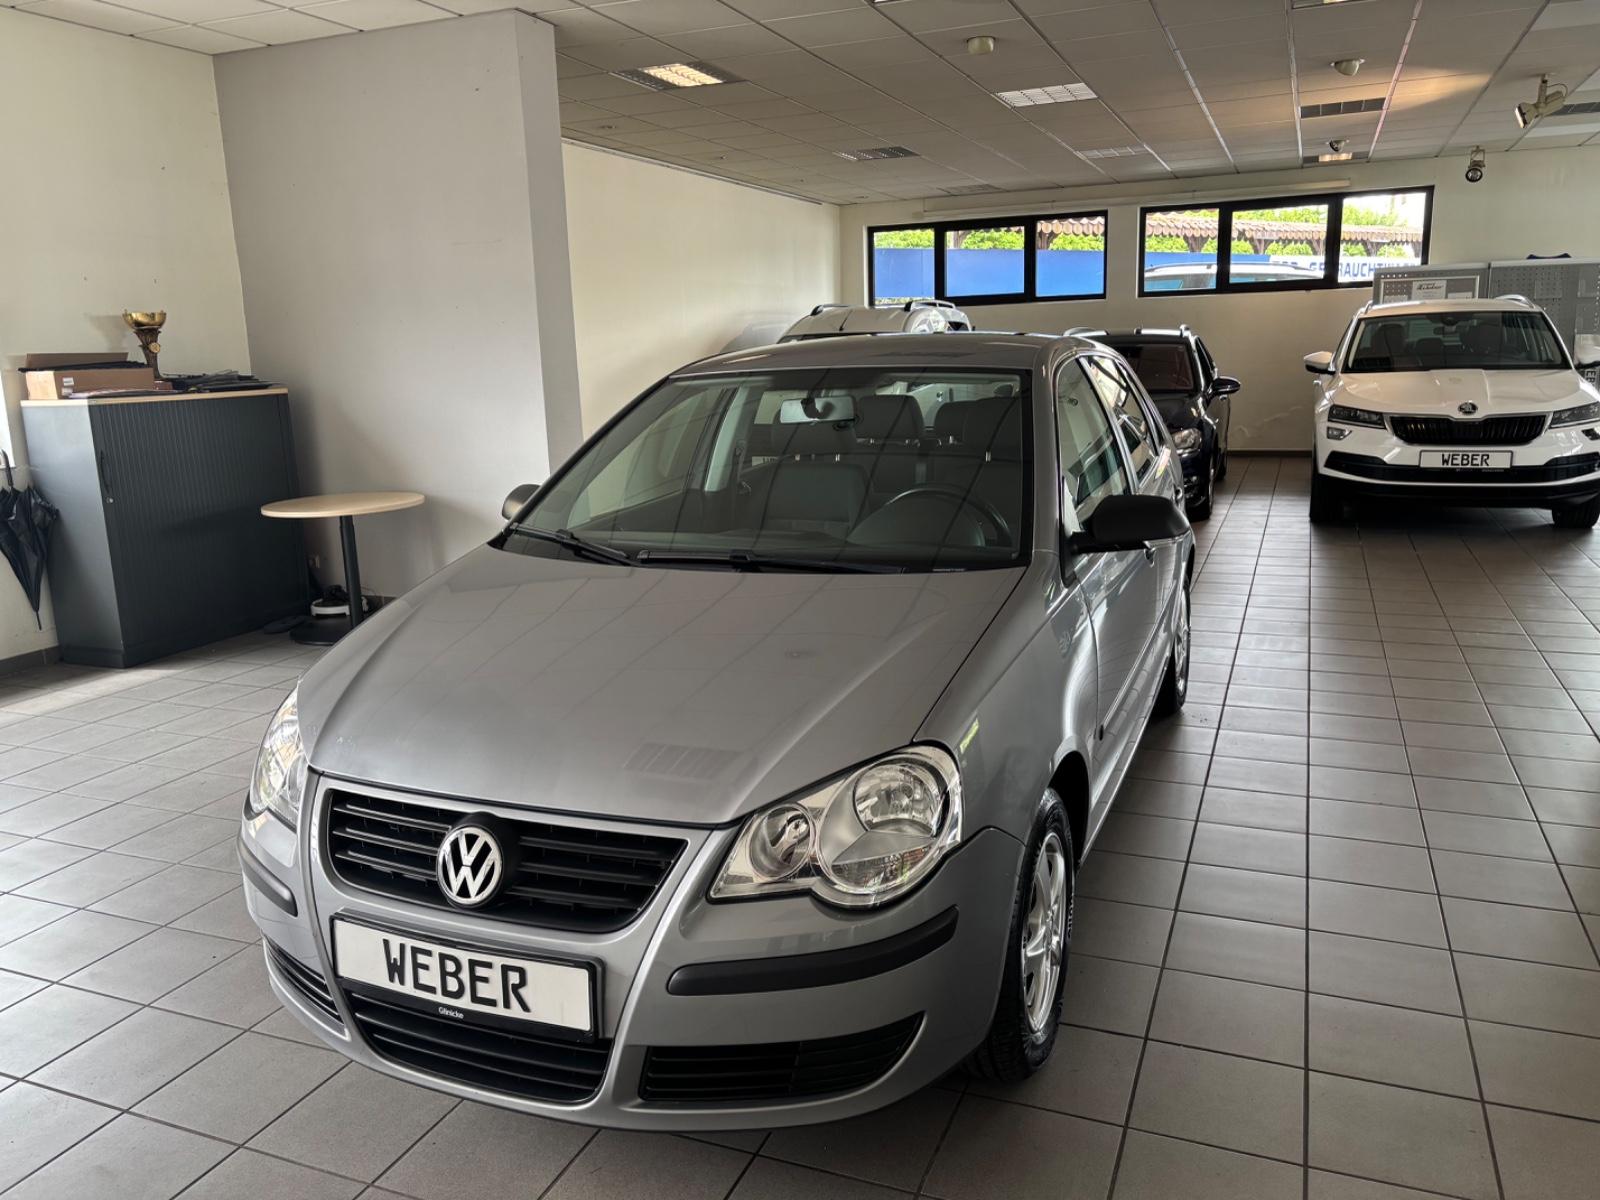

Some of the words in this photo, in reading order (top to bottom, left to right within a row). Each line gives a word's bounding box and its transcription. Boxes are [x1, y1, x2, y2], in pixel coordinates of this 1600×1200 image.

[1441, 453, 1490, 467] WEBER
[438, 827, 502, 905] VW
[382, 938, 532, 1013] WEBER
